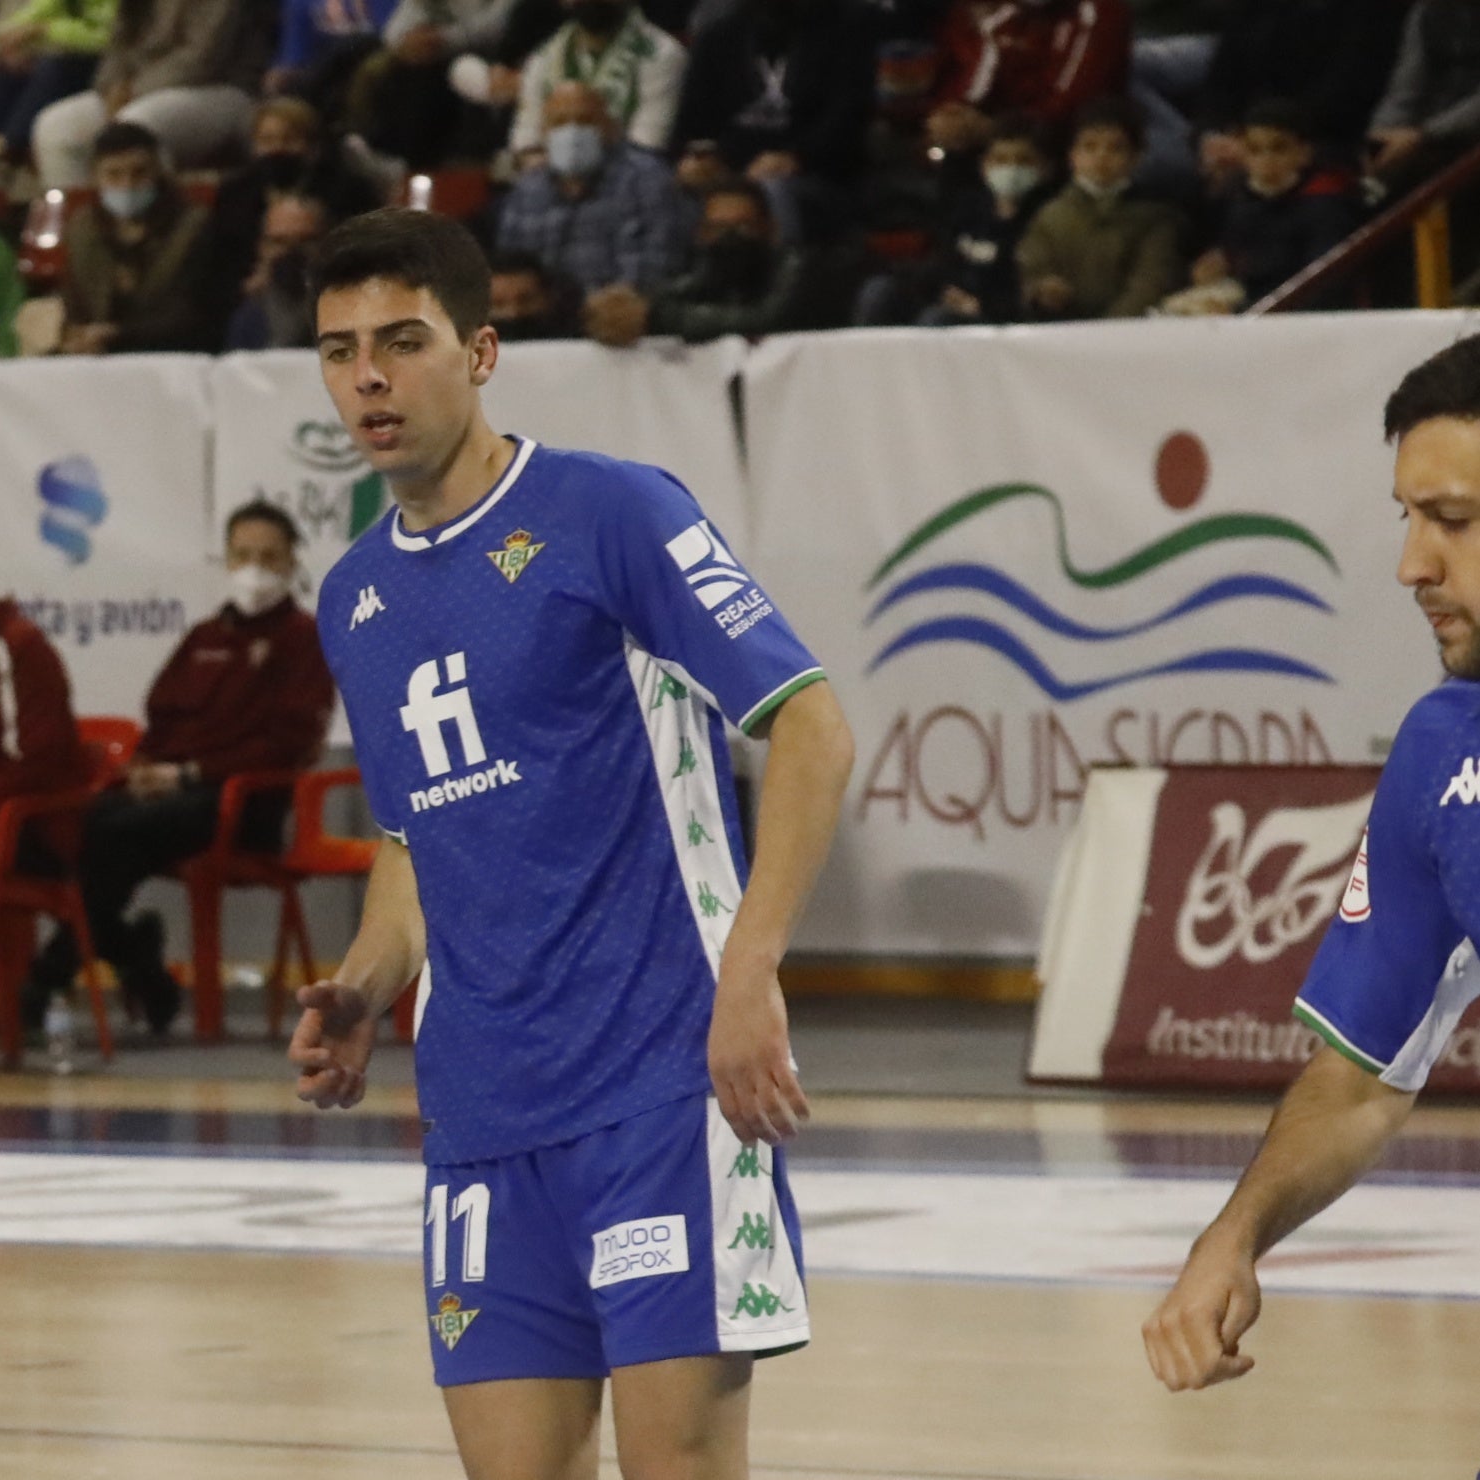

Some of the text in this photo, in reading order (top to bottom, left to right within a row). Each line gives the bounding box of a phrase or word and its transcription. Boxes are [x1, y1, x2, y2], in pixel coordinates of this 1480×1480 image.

[713, 587, 768, 630] REALE
[726, 602, 775, 640] SEGUROS
[398, 651, 488, 778] fi
[409, 758, 523, 814] network
[854, 704, 1091, 843] AQUA
[1148, 1005, 1326, 1066] Instituto
[426, 1183, 491, 1289] 11
